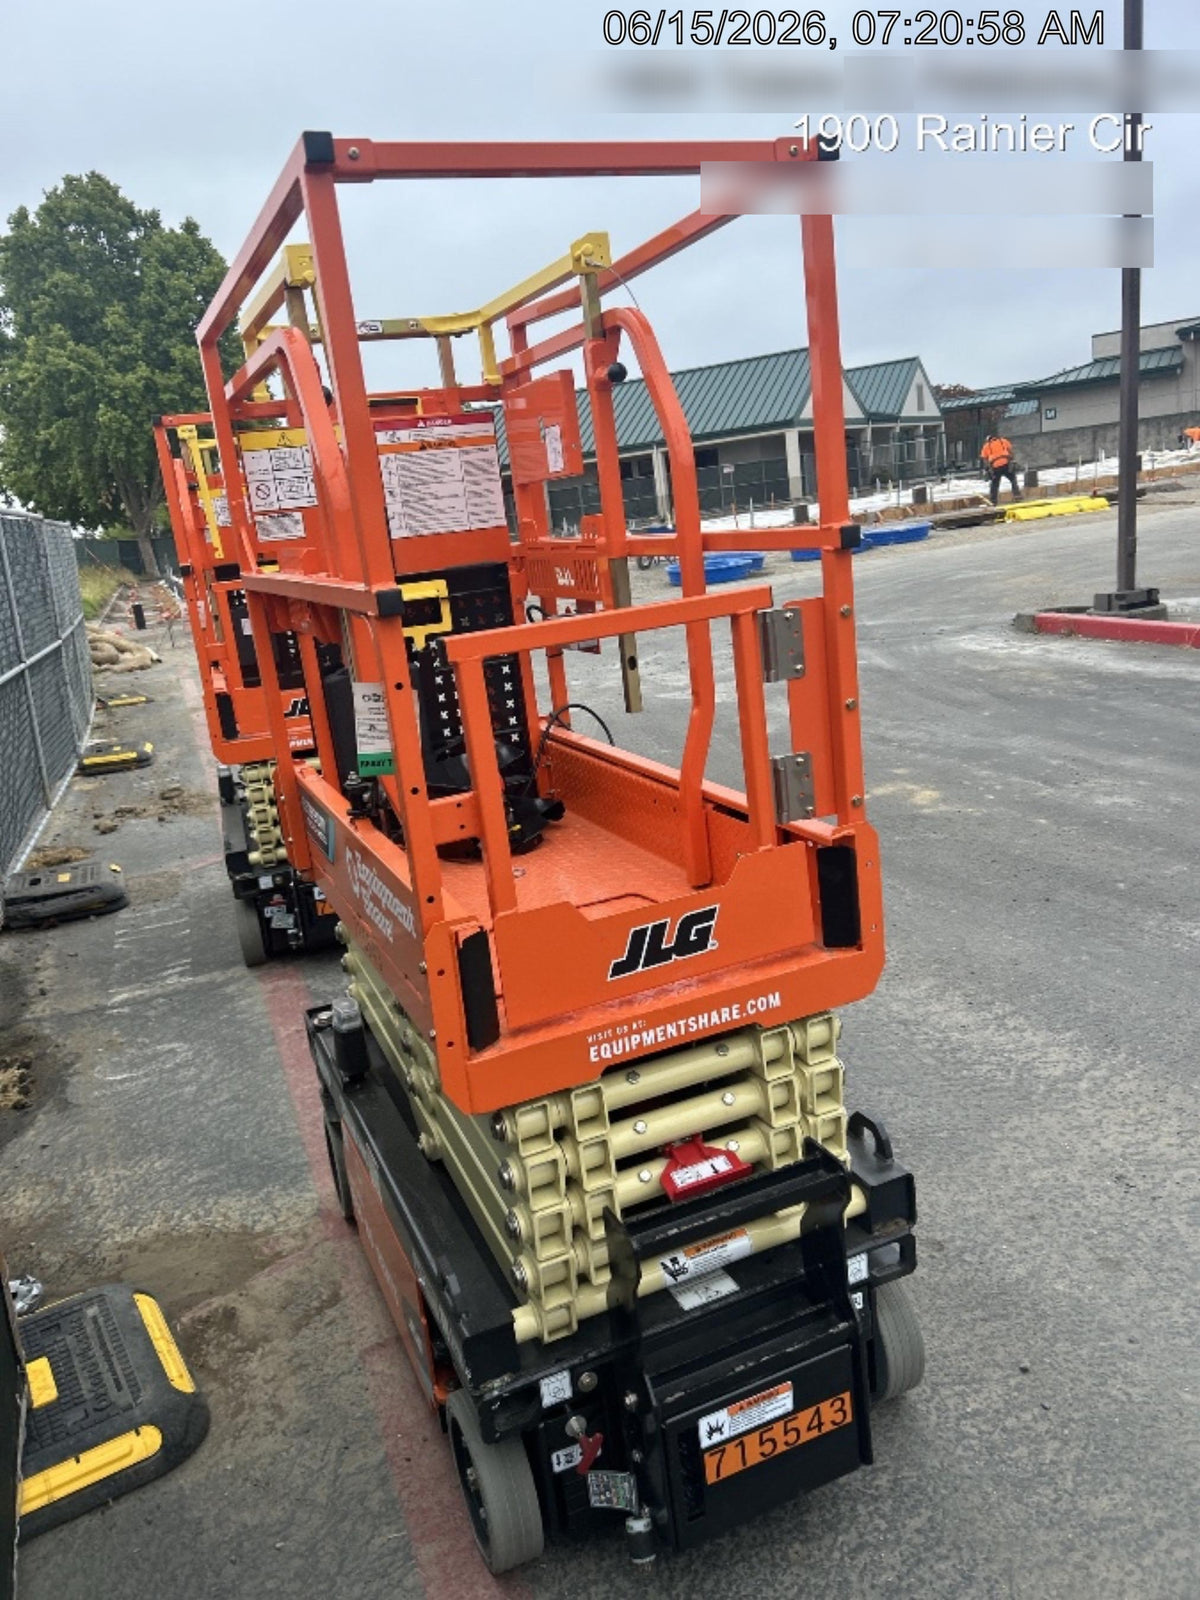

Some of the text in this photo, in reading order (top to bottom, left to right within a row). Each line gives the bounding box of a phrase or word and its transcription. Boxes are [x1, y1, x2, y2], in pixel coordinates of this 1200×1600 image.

[608, 904, 720, 981] JLG
[586, 1028, 613, 1043] VISIT
[616, 1025, 629, 1036] US
[589, 992, 782, 1063] EQUIPMENTSHARE.COM
[708, 1396, 848, 1479] 715543
